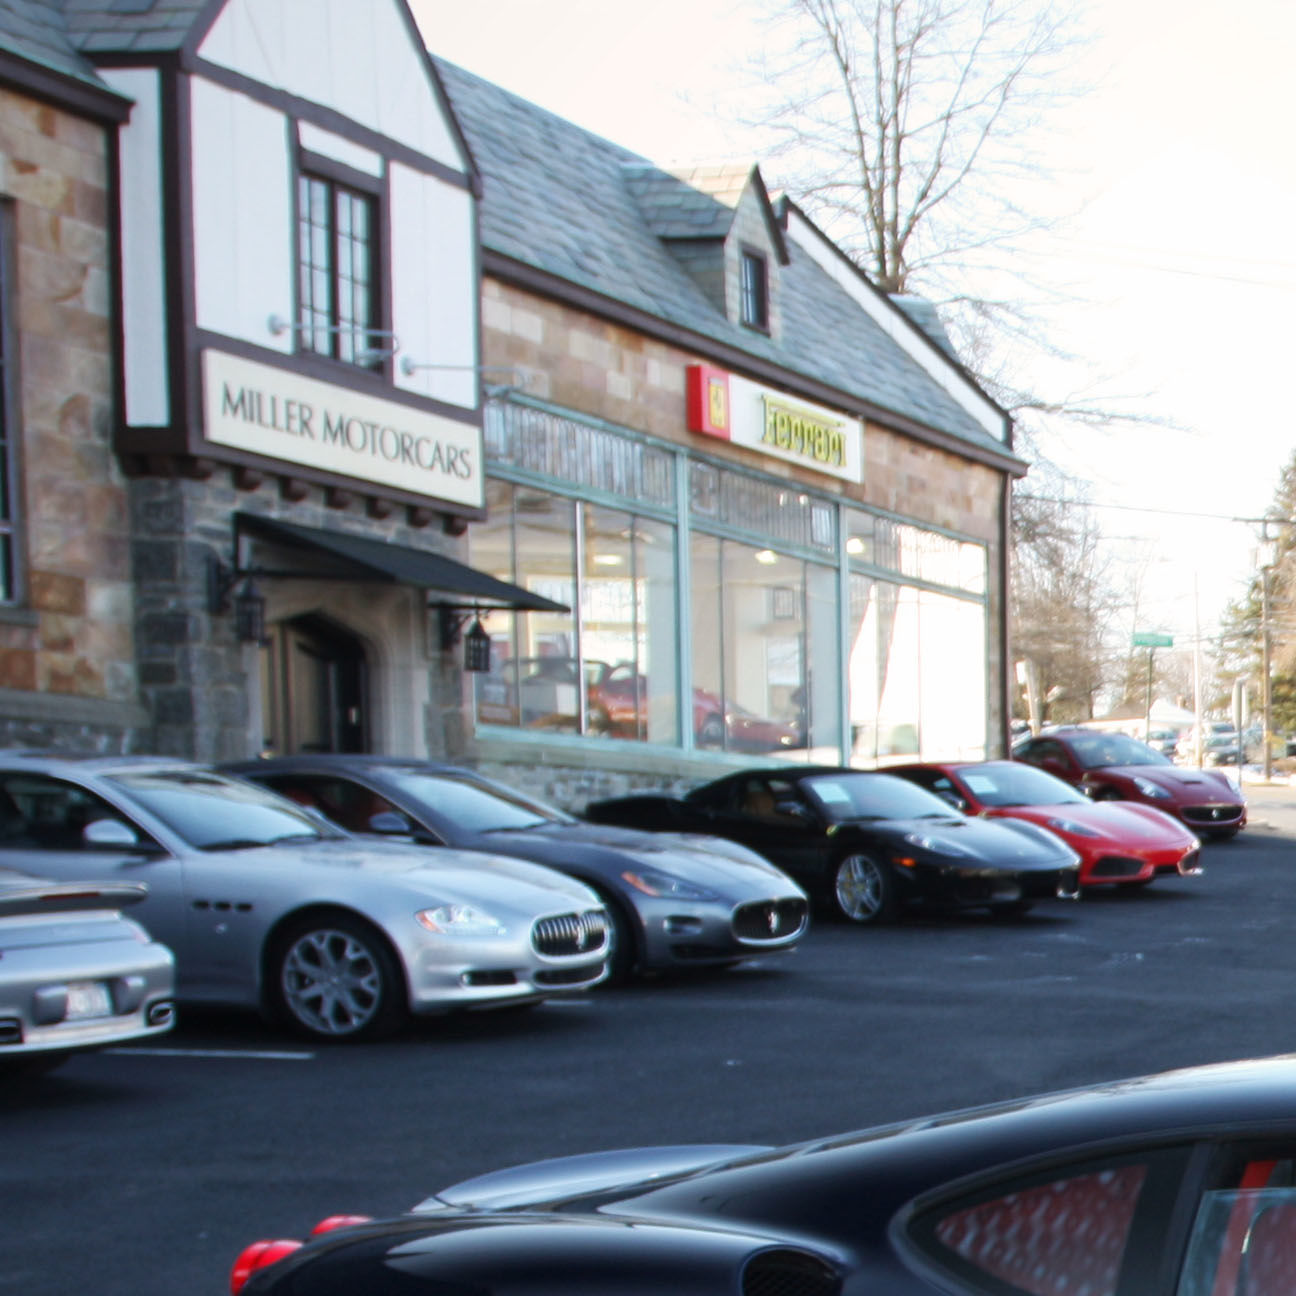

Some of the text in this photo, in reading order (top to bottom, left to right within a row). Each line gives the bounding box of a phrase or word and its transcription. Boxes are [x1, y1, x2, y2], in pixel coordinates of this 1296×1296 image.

[221, 381, 472, 480] MILLER MOTORCARS
[760, 394, 847, 467] Ferrari
